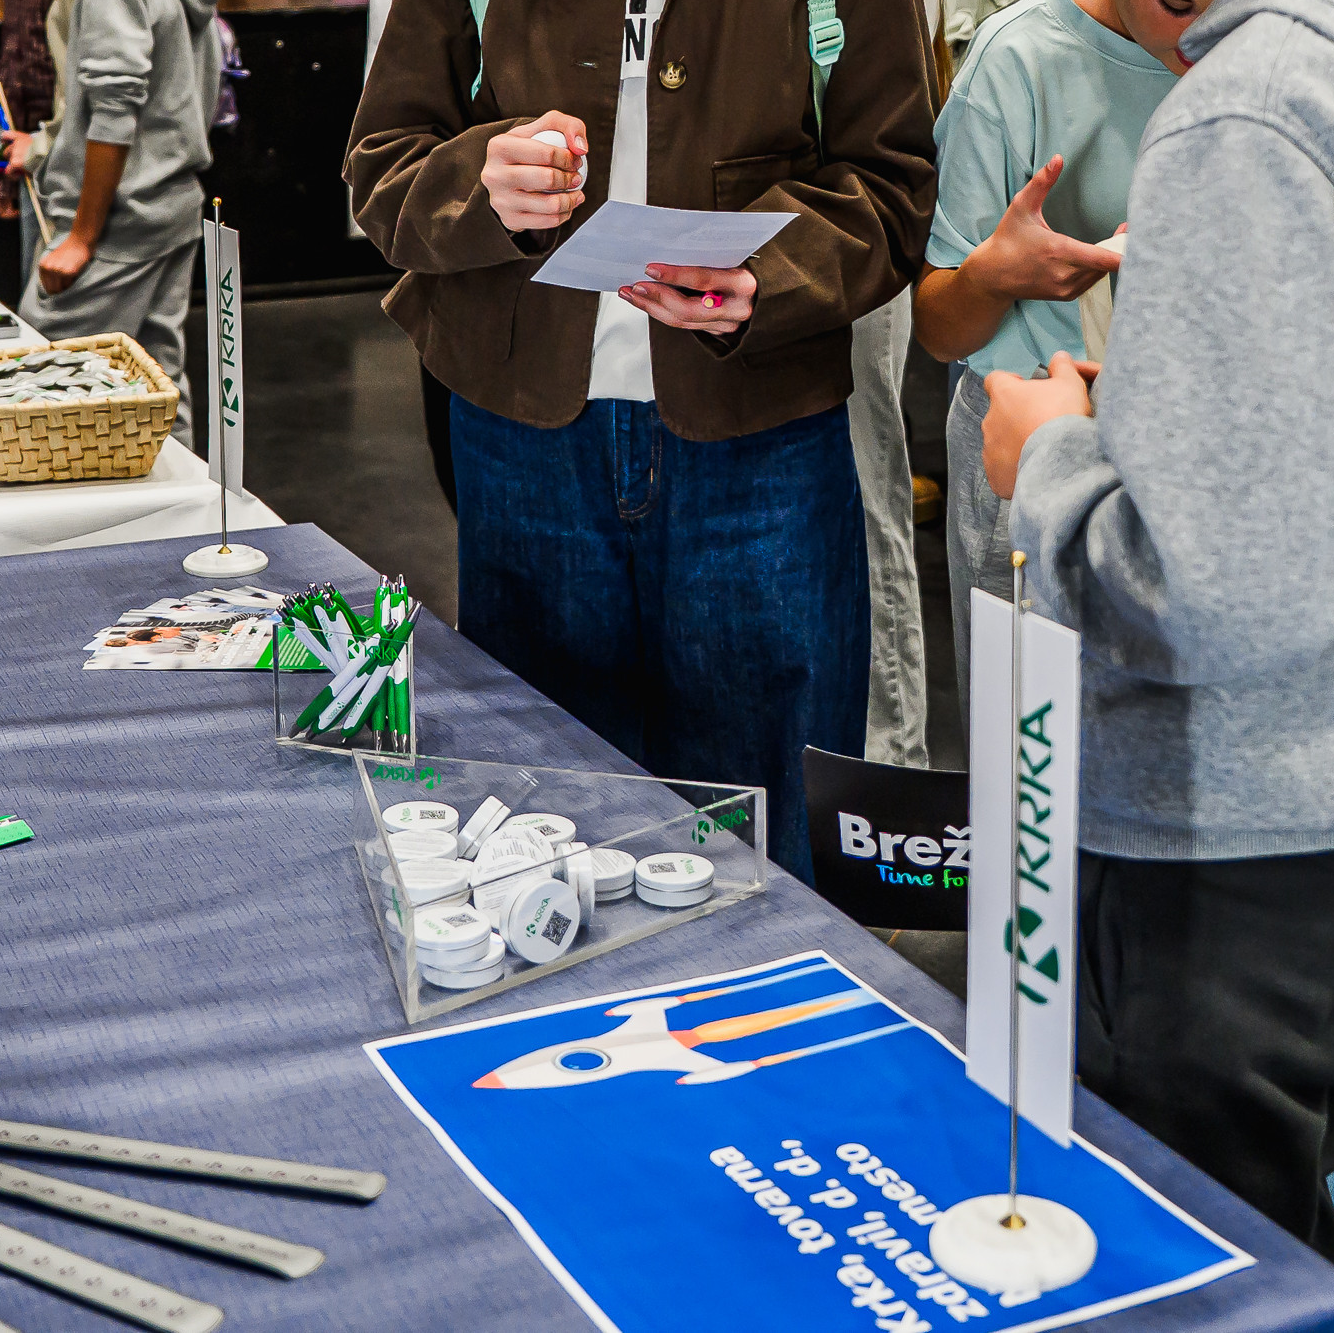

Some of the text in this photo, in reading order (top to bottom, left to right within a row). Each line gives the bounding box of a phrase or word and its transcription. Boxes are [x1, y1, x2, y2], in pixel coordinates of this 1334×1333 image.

[220, 266, 235, 367] KRKA
[1015, 699, 1053, 893] KRKA
[838, 811, 970, 868] Brež
[876, 864, 934, 886] Time
[809, 1177, 858, 1209] d.
[835, 1142, 944, 1226] mesto
[846, 1210, 989, 1322] zdravil,
